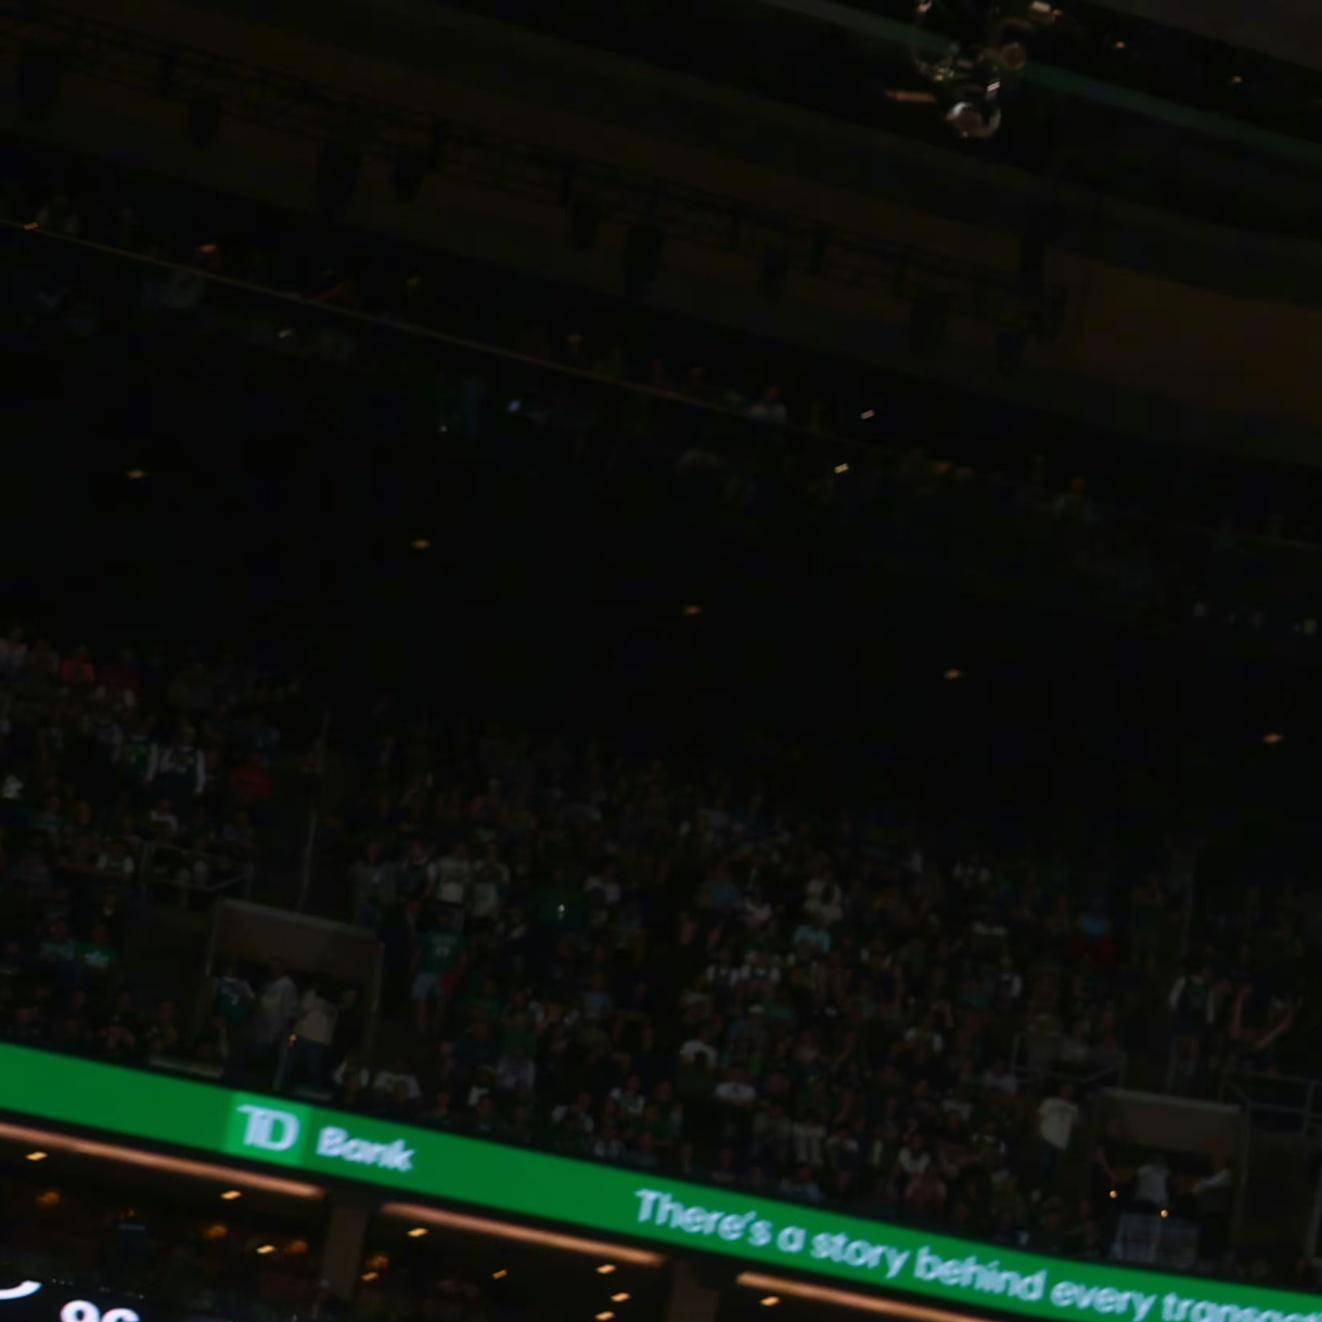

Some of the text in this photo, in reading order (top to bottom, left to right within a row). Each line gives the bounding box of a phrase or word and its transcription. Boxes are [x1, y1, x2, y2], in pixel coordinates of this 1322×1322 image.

[237, 1104, 414, 1173] TD Bank
[635, 1188, 772, 1247] There's
[778, 1225, 805, 1253] a
[810, 1230, 909, 1279] story
[913, 1246, 1044, 1306] behind
